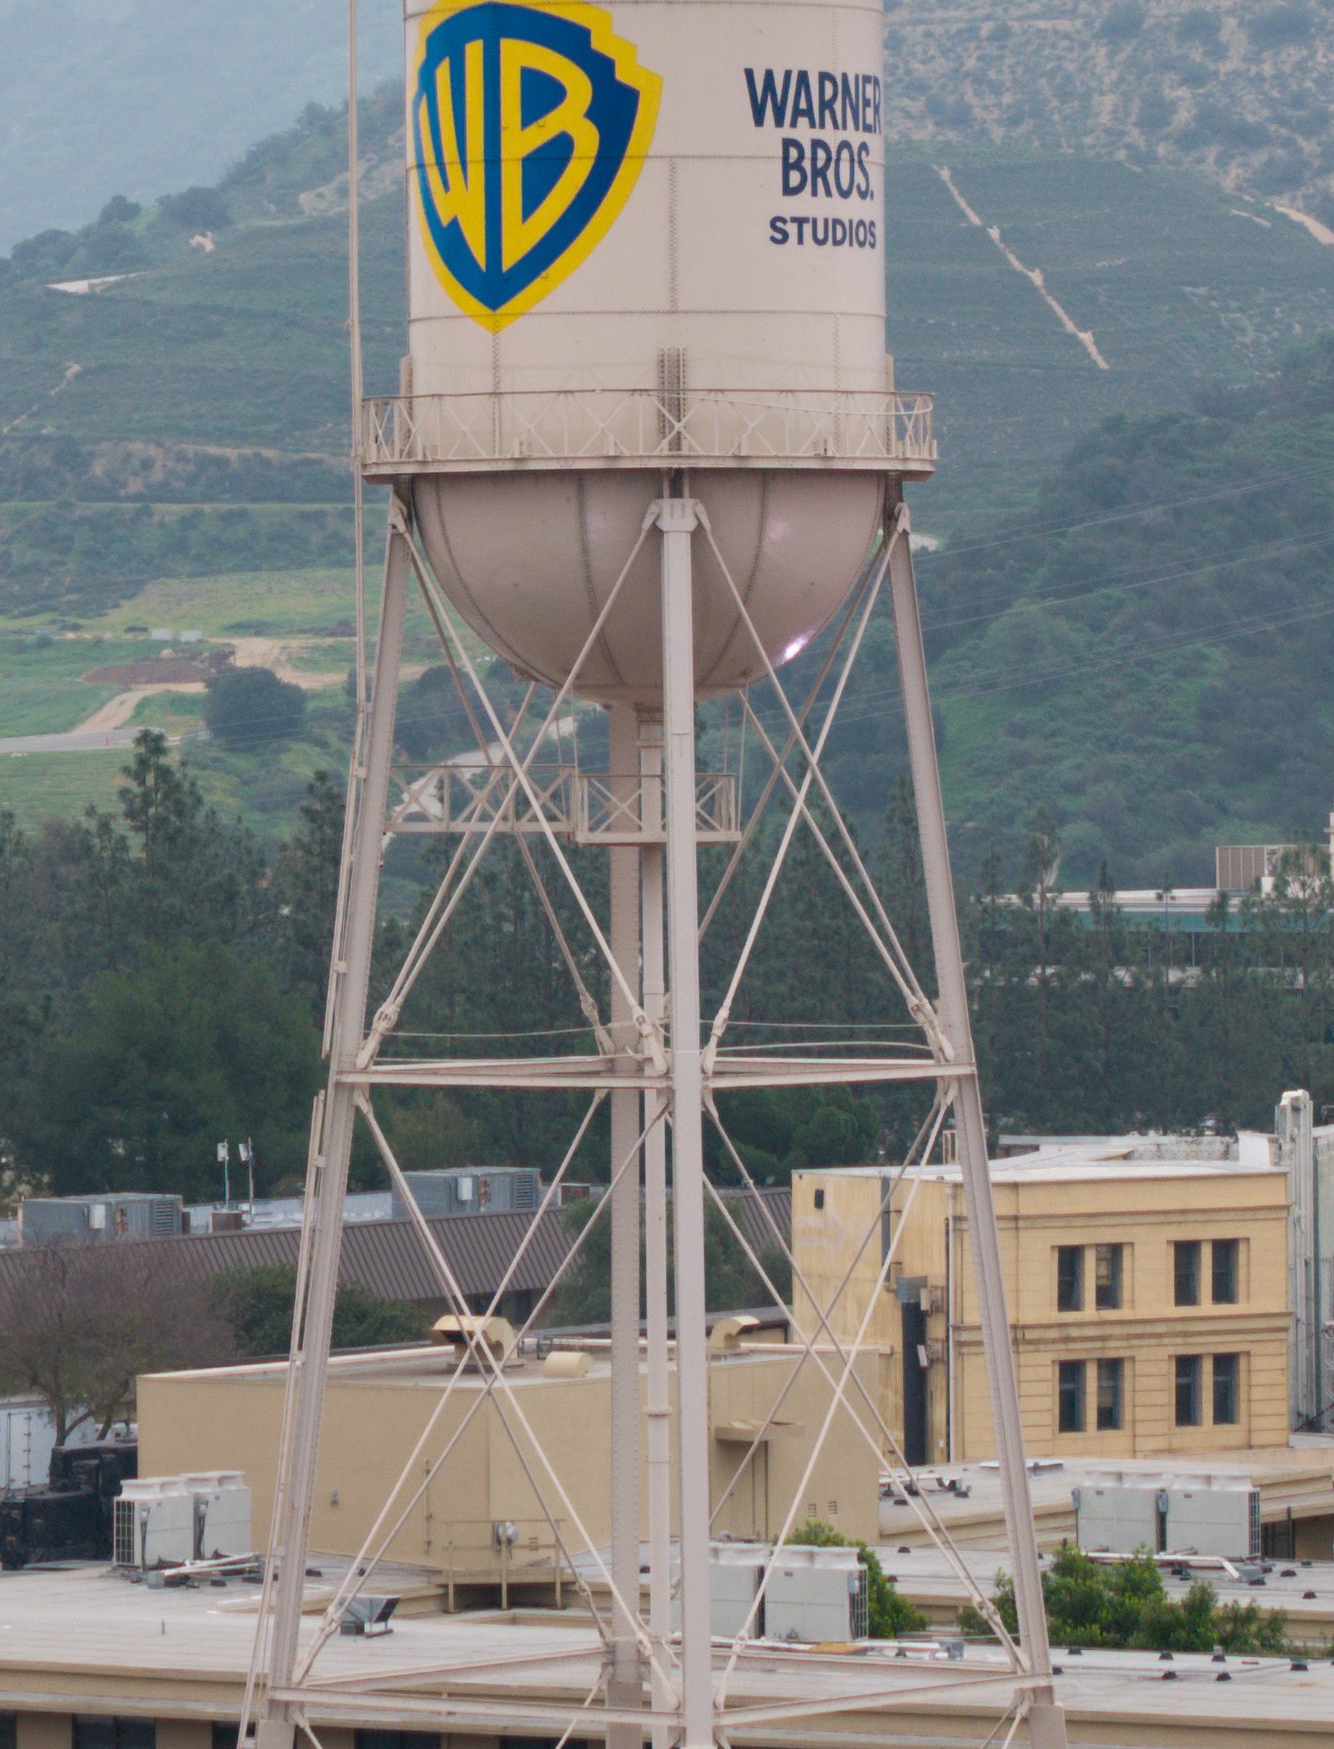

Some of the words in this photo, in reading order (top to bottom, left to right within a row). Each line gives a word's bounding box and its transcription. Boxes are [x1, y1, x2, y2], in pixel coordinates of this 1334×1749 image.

[744, 68, 881, 135] WARNER
[418, 37, 600, 273] WB
[782, 138, 874, 201] BROS.
[769, 216, 876, 249] STUDIOS
